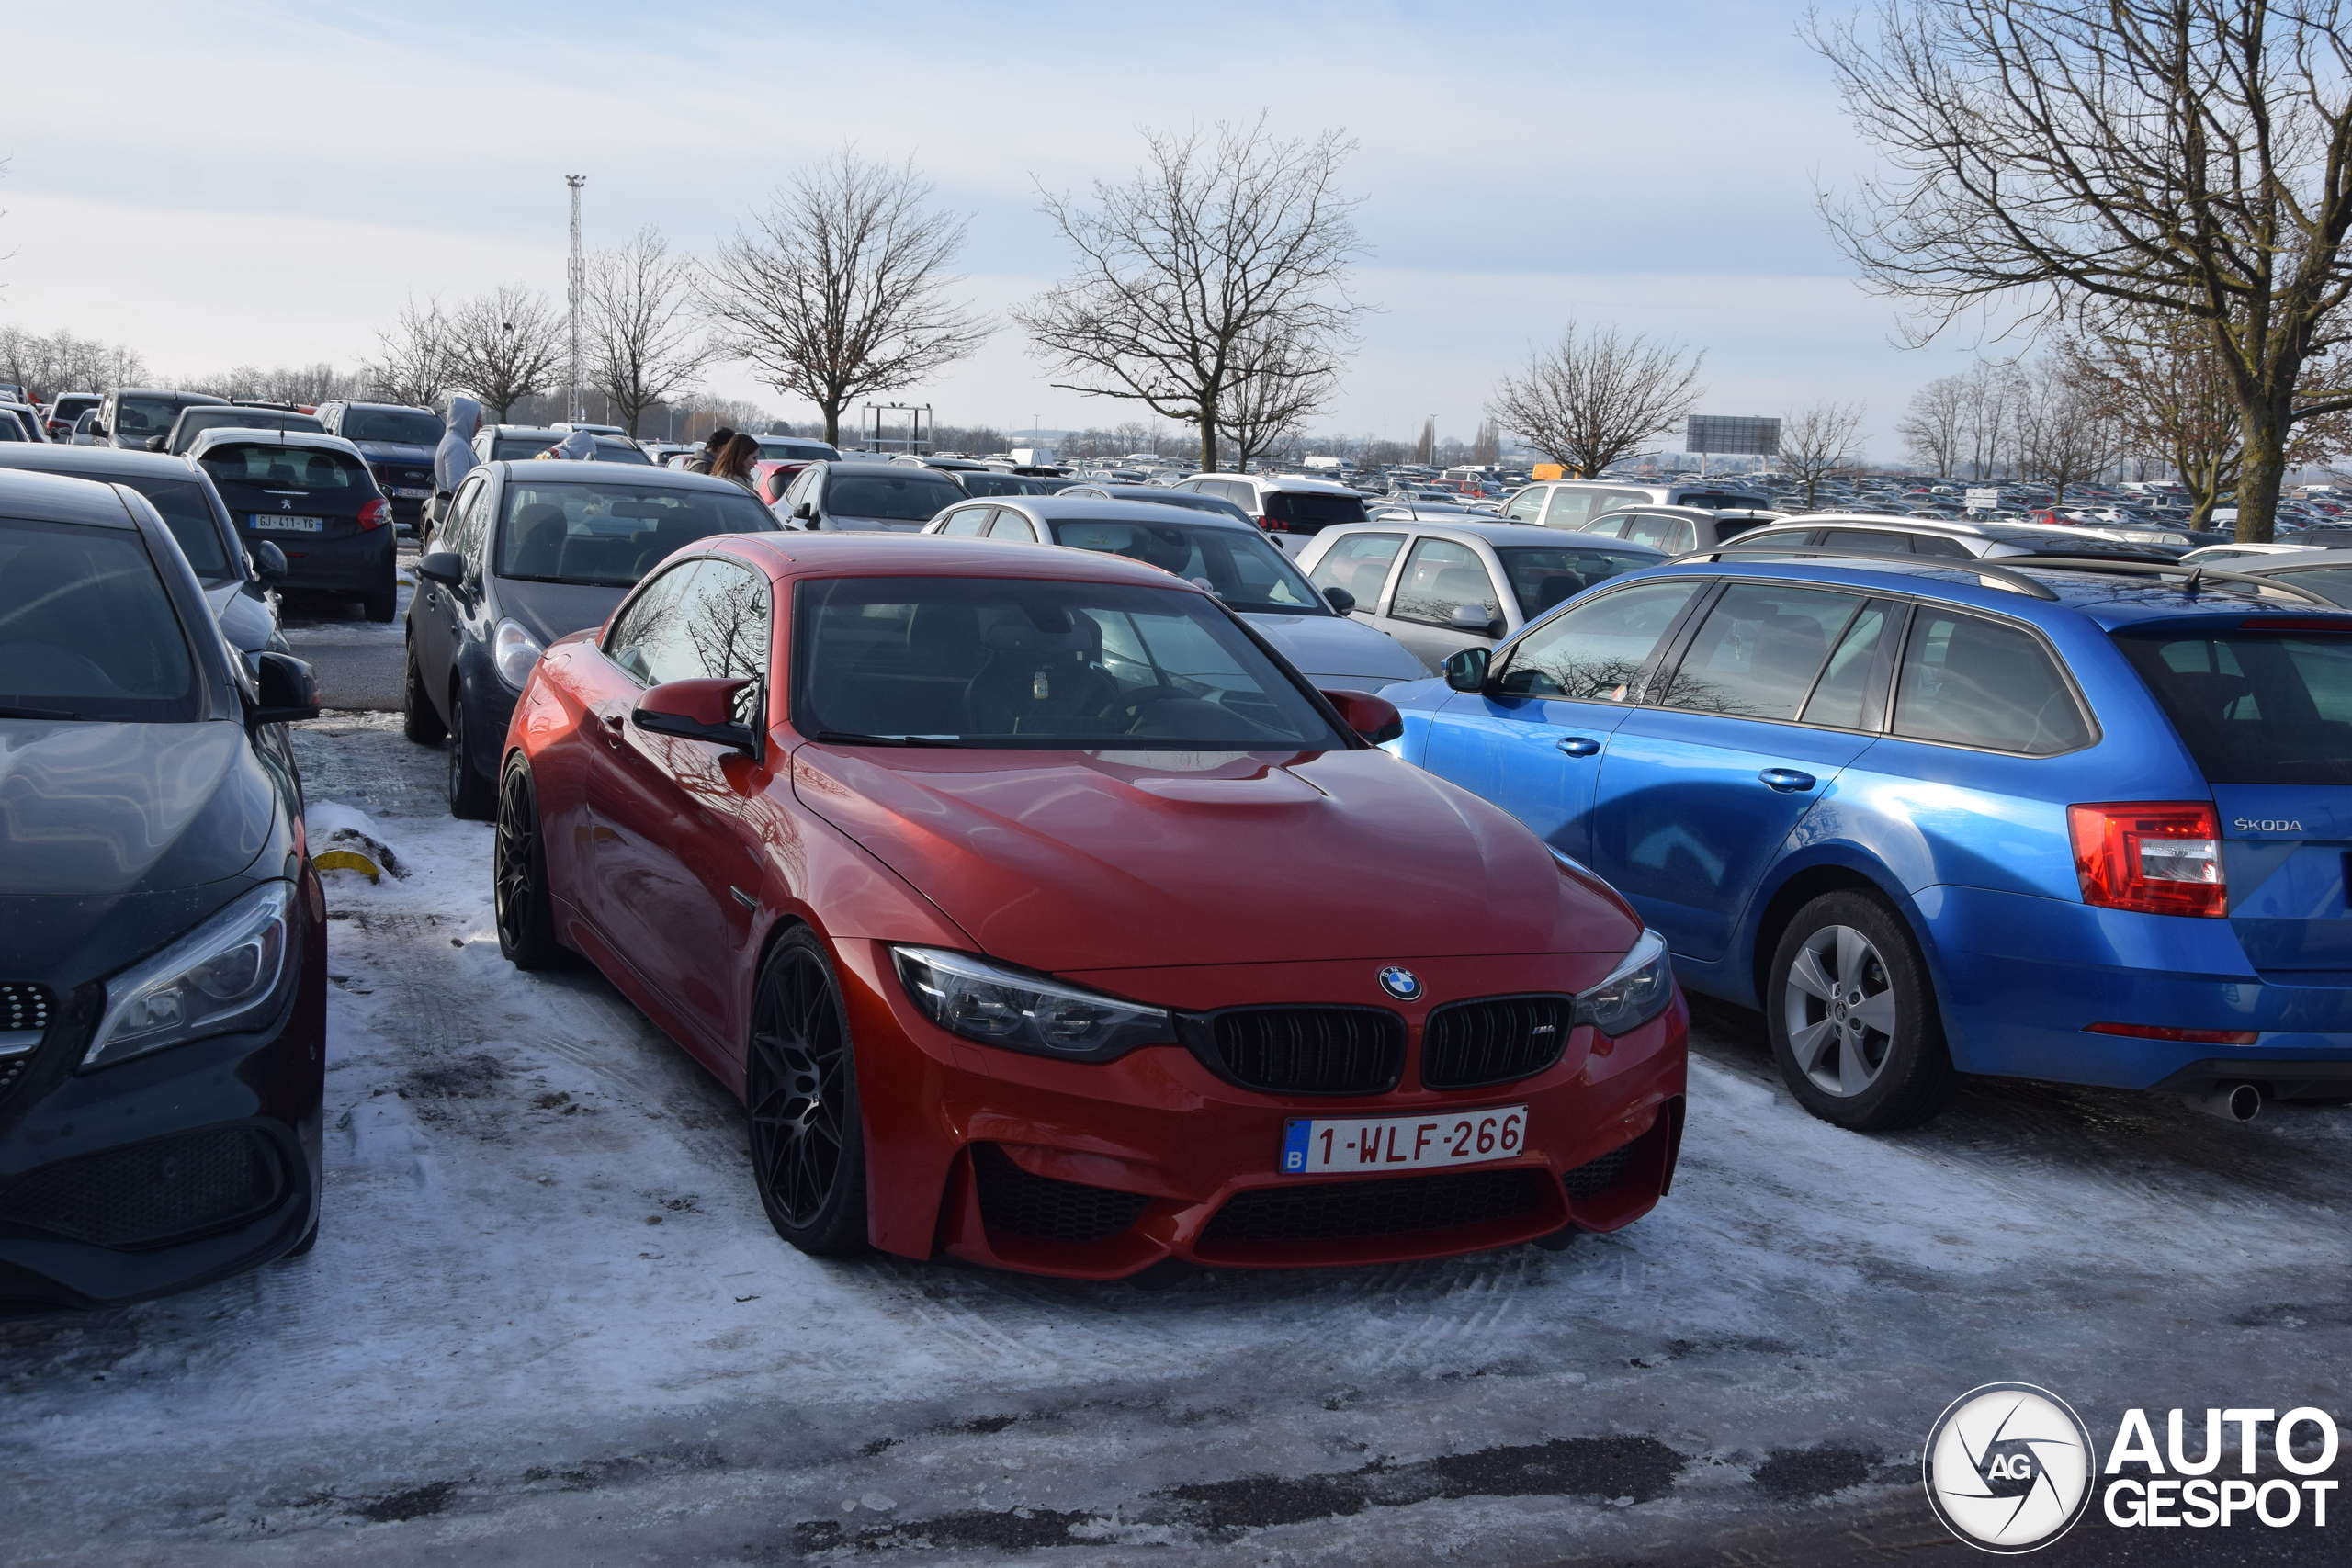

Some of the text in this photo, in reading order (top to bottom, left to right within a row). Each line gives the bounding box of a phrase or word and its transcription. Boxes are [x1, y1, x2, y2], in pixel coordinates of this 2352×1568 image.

[2233, 817, 2302, 831] ŠKODA
[1381, 966, 1413, 978] BMW
[1287, 1114, 1521, 1168] B 1-WLF-266
